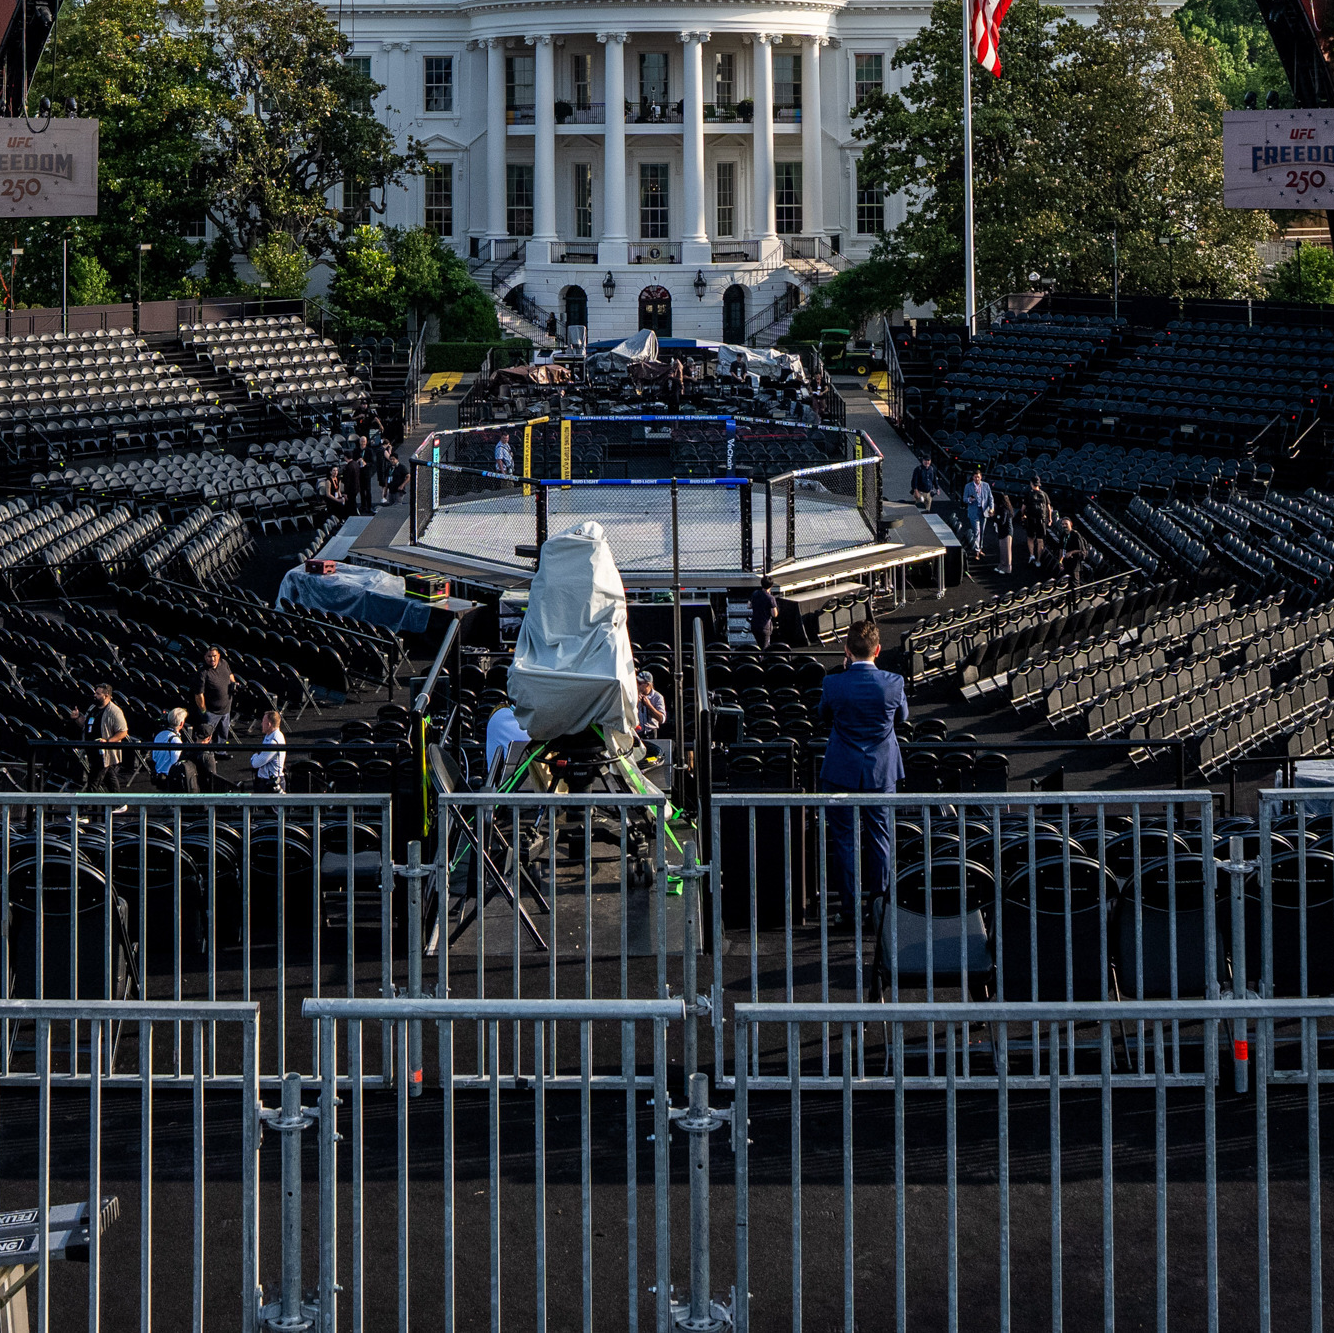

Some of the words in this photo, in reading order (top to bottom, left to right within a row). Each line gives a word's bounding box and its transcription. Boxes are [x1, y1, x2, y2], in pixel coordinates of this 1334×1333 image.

[7, 137, 33, 147] UFC
[1290, 129, 1316, 139] UFC
[1, 178, 41, 202] 250
[1285, 170, 1326, 194] 250
